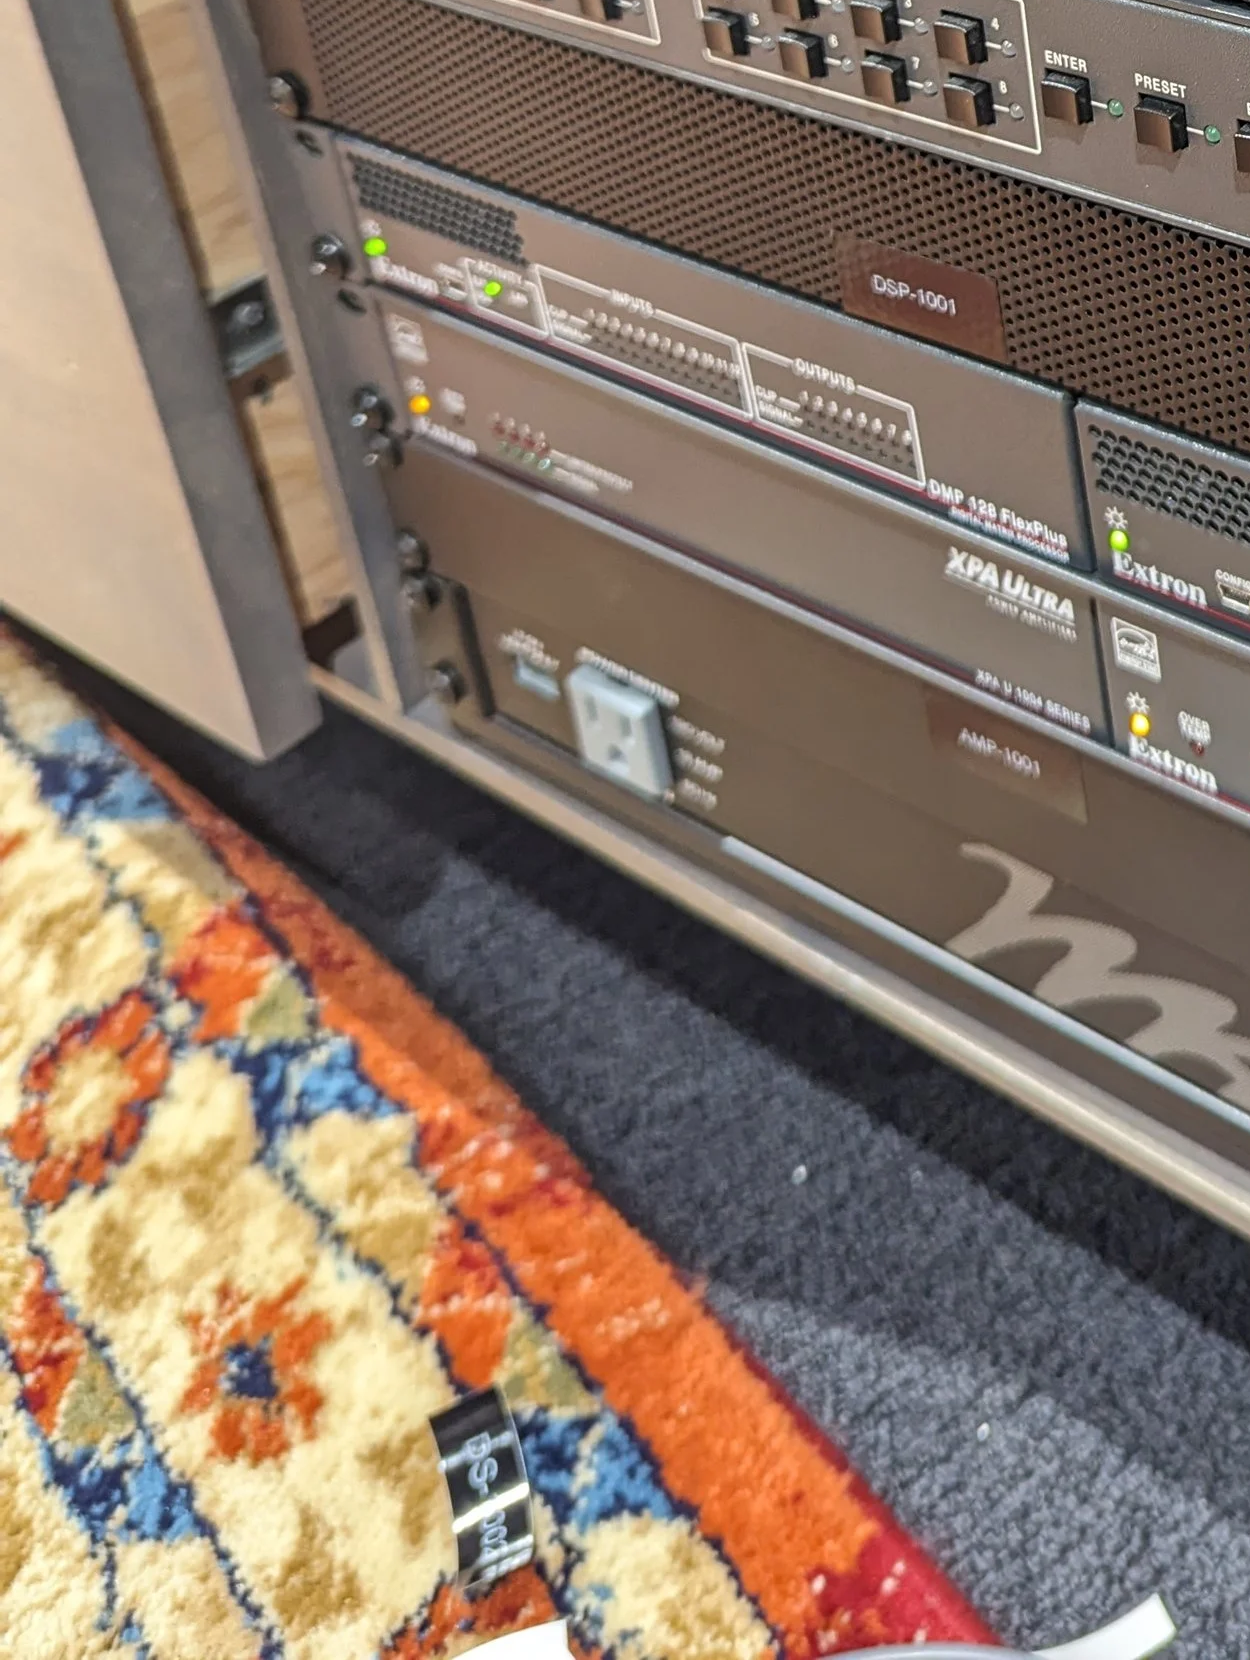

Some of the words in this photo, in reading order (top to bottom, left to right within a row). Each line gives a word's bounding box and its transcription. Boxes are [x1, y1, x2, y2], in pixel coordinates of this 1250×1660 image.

[1044, 50, 1088, 73] ENTER
[1135, 73, 1187, 98] PRESET
[871, 274, 956, 317] DSP-1001
[791, 356, 856, 396] OUTPUTS
[927, 477, 965, 508] DMP
[967, 495, 998, 522] 128
[1000, 506, 1069, 550] FlexPlus
[945, 546, 999, 590] XPA
[1001, 568, 1074, 622] ULTRA
[1112, 550, 1208, 609] Extron
[974, 667, 1001, 690] XPA
[1043, 698, 1091, 736] SERIES
[1178, 710, 1210, 730] OVER
[957, 726, 1040, 780] AMP-1001
[1129, 732, 1217, 794] Extron
